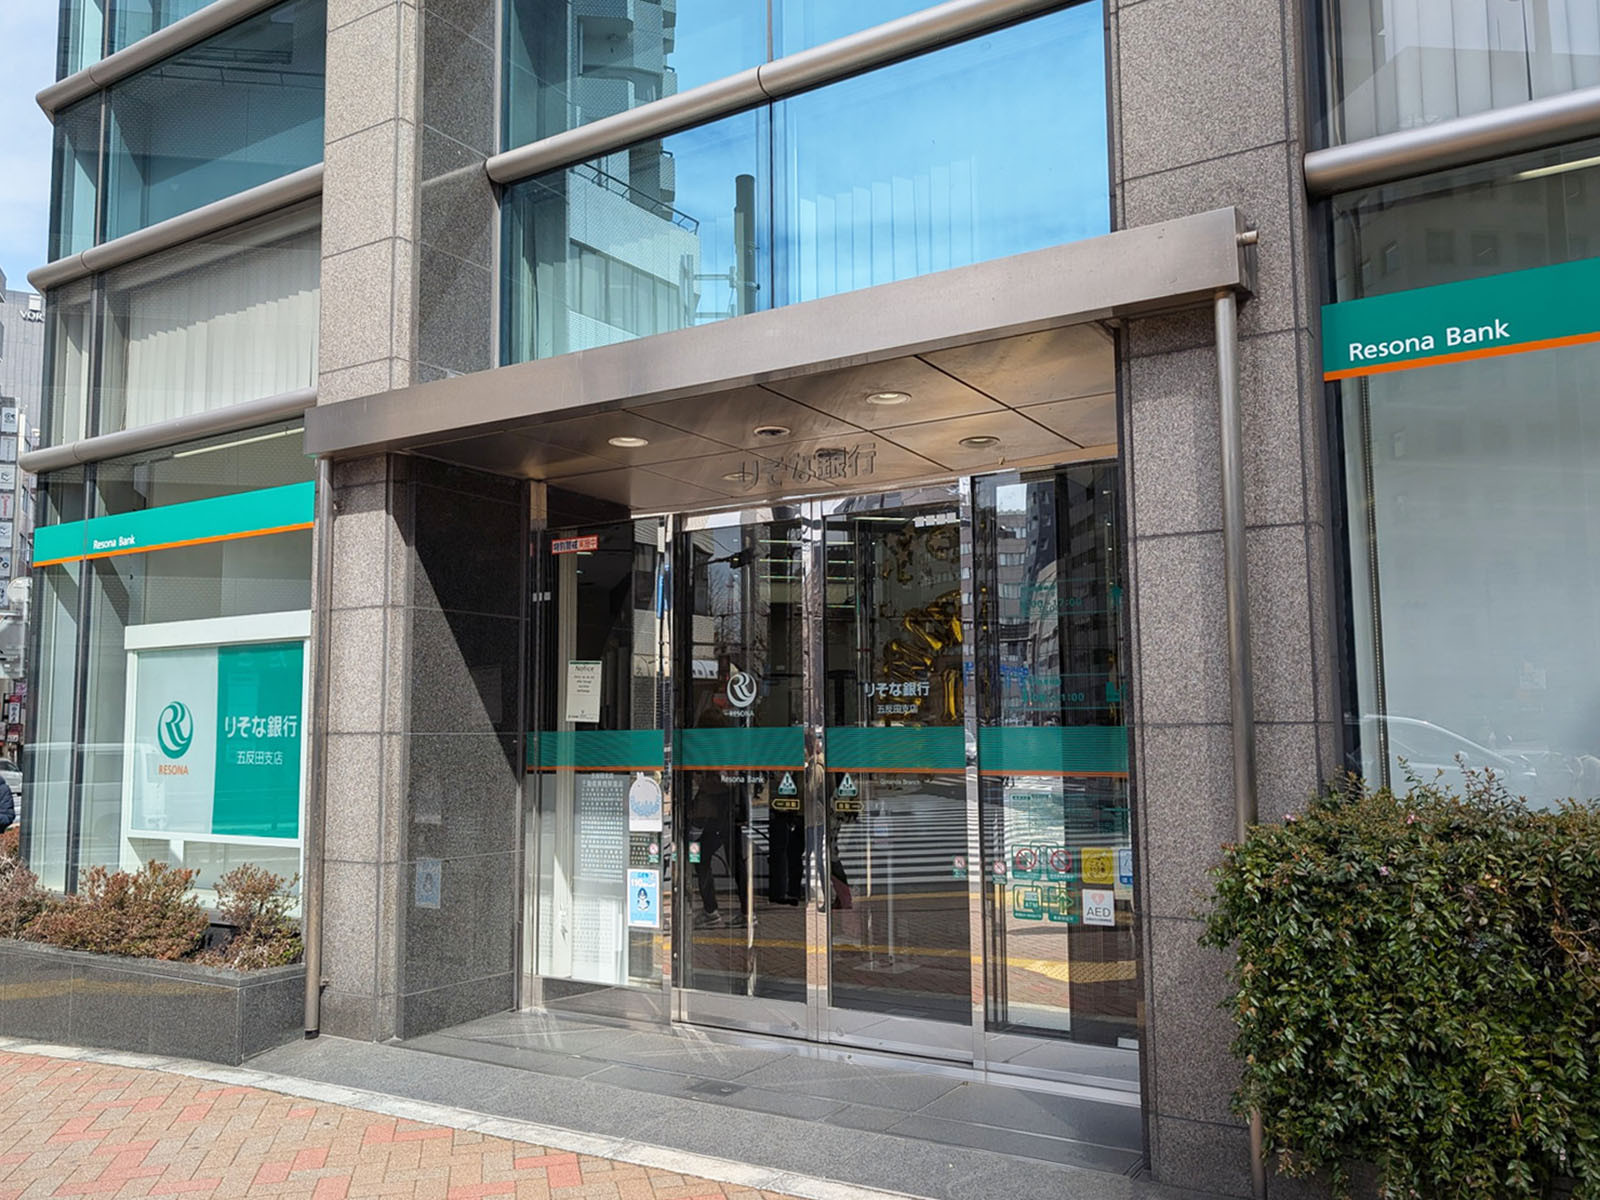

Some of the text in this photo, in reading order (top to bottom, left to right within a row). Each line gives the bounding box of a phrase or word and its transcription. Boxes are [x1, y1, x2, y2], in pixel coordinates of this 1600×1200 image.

[1348, 318, 1511, 362] Resona Bank
[739, 442, 877, 491] りそな銀行
[93, 534, 136, 550] Resona Bank
[864, 681, 930, 698] りそな銀行
[876, 704, 919, 714] 五反田支店
[224, 715, 298, 738] りそな銀行
[236, 751, 284, 765] 五反田支店
[158, 764, 189, 775] RESONA
[720, 773, 765, 784] Resona Bank
[1086, 906, 1112, 918] AED
